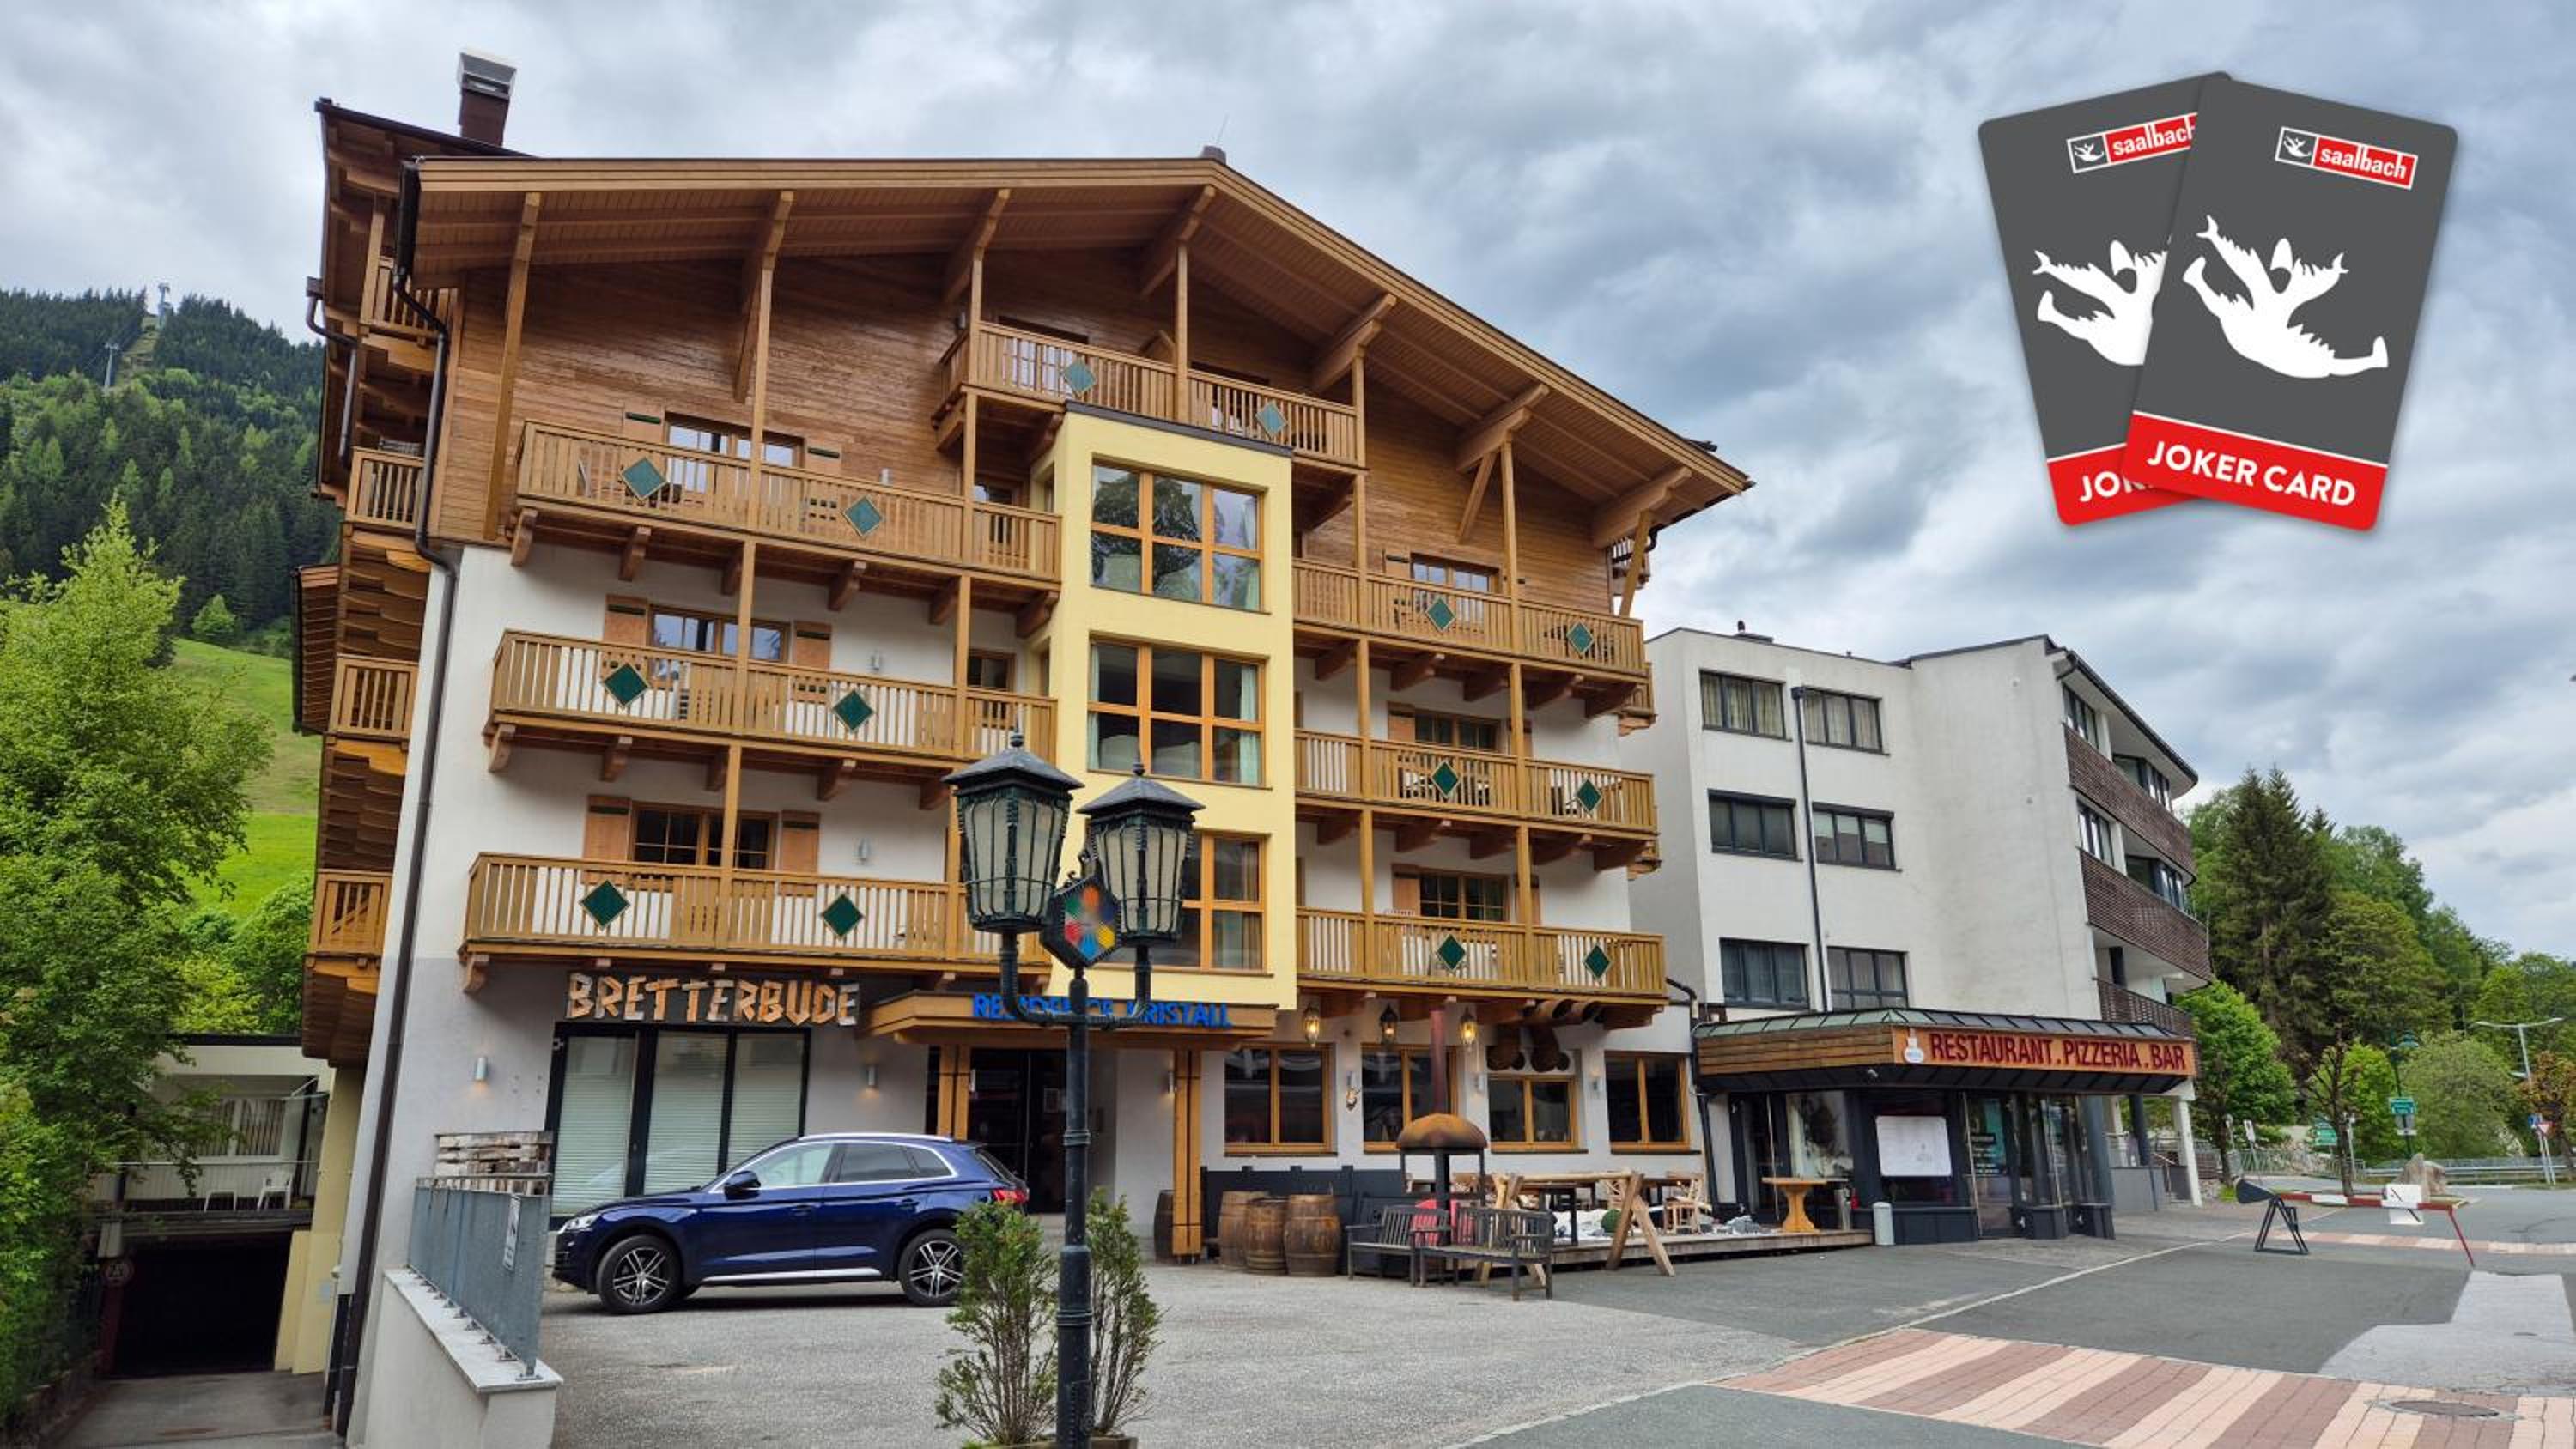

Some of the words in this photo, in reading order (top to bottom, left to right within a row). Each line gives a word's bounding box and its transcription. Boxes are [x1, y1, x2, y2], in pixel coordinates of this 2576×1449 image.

[565, 972, 859, 1026] BRETTERBUDE
[1929, 1033, 2052, 1064] RESTAURANT
[2063, 1040, 2140, 1067] PIZZERIA
[2149, 1044, 2185, 1070] BAR
